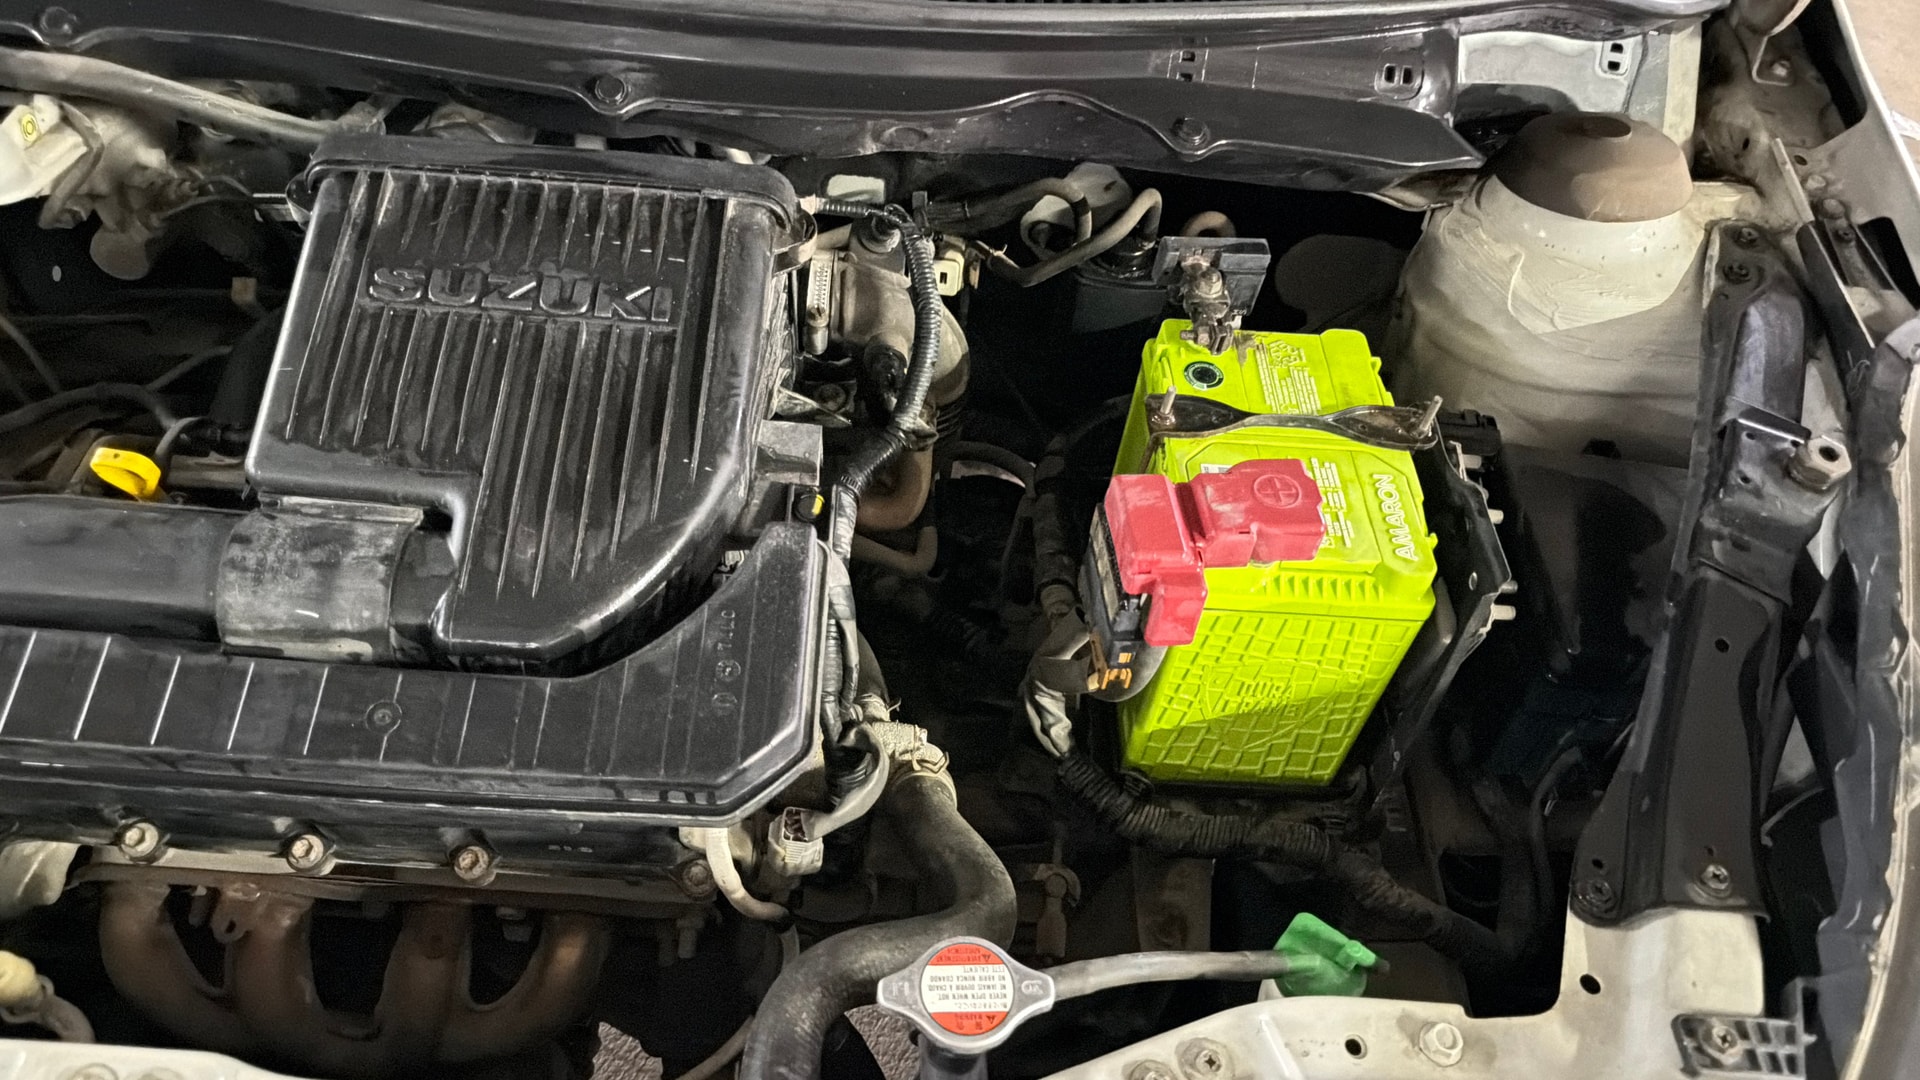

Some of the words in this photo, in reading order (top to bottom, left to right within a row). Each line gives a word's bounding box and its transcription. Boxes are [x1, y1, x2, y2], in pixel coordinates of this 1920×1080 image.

[369, 267, 673, 321] SUZUKI
[1372, 473, 1419, 561] AMARON
[930, 975, 954, 983] CUANDO
